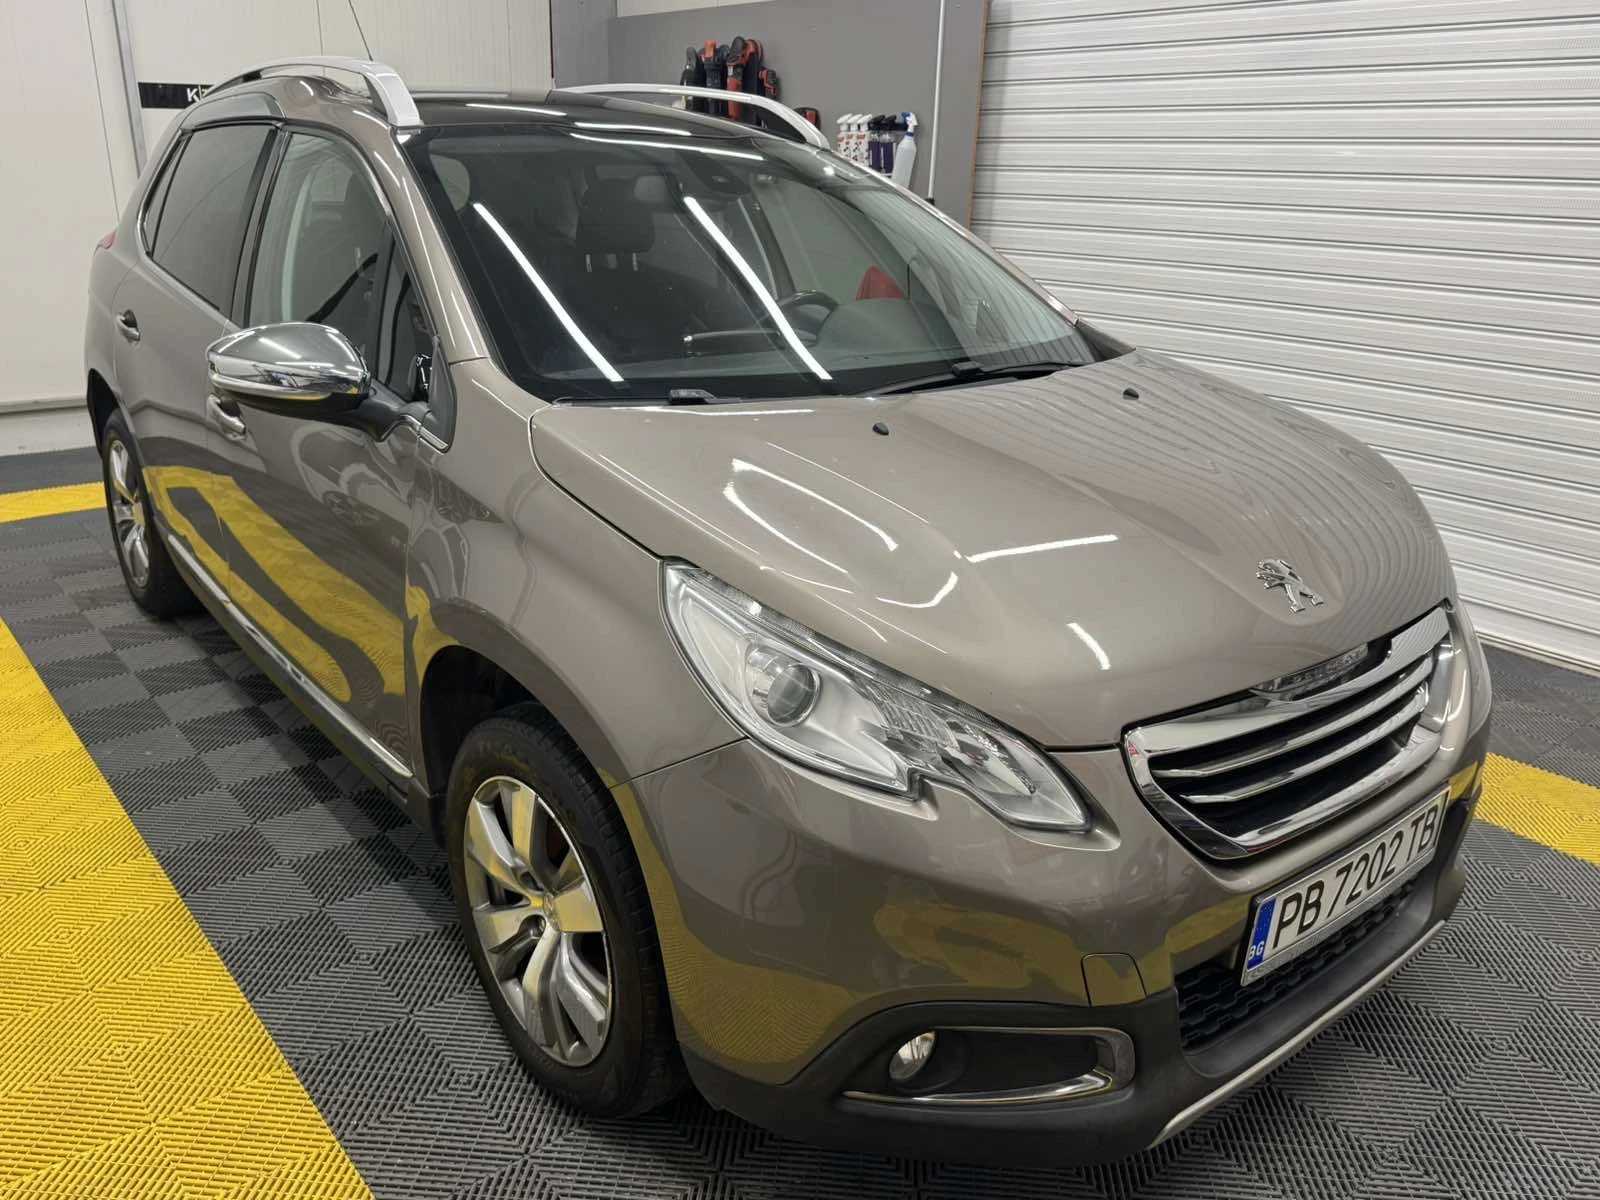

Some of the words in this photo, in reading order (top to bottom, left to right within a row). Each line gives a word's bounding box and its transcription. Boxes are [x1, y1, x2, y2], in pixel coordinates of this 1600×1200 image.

[1273, 880, 1325, 949] PB
[1327, 830, 1403, 917] 7202
[1406, 805, 1438, 862] TB
[1248, 940, 1264, 961] BG
